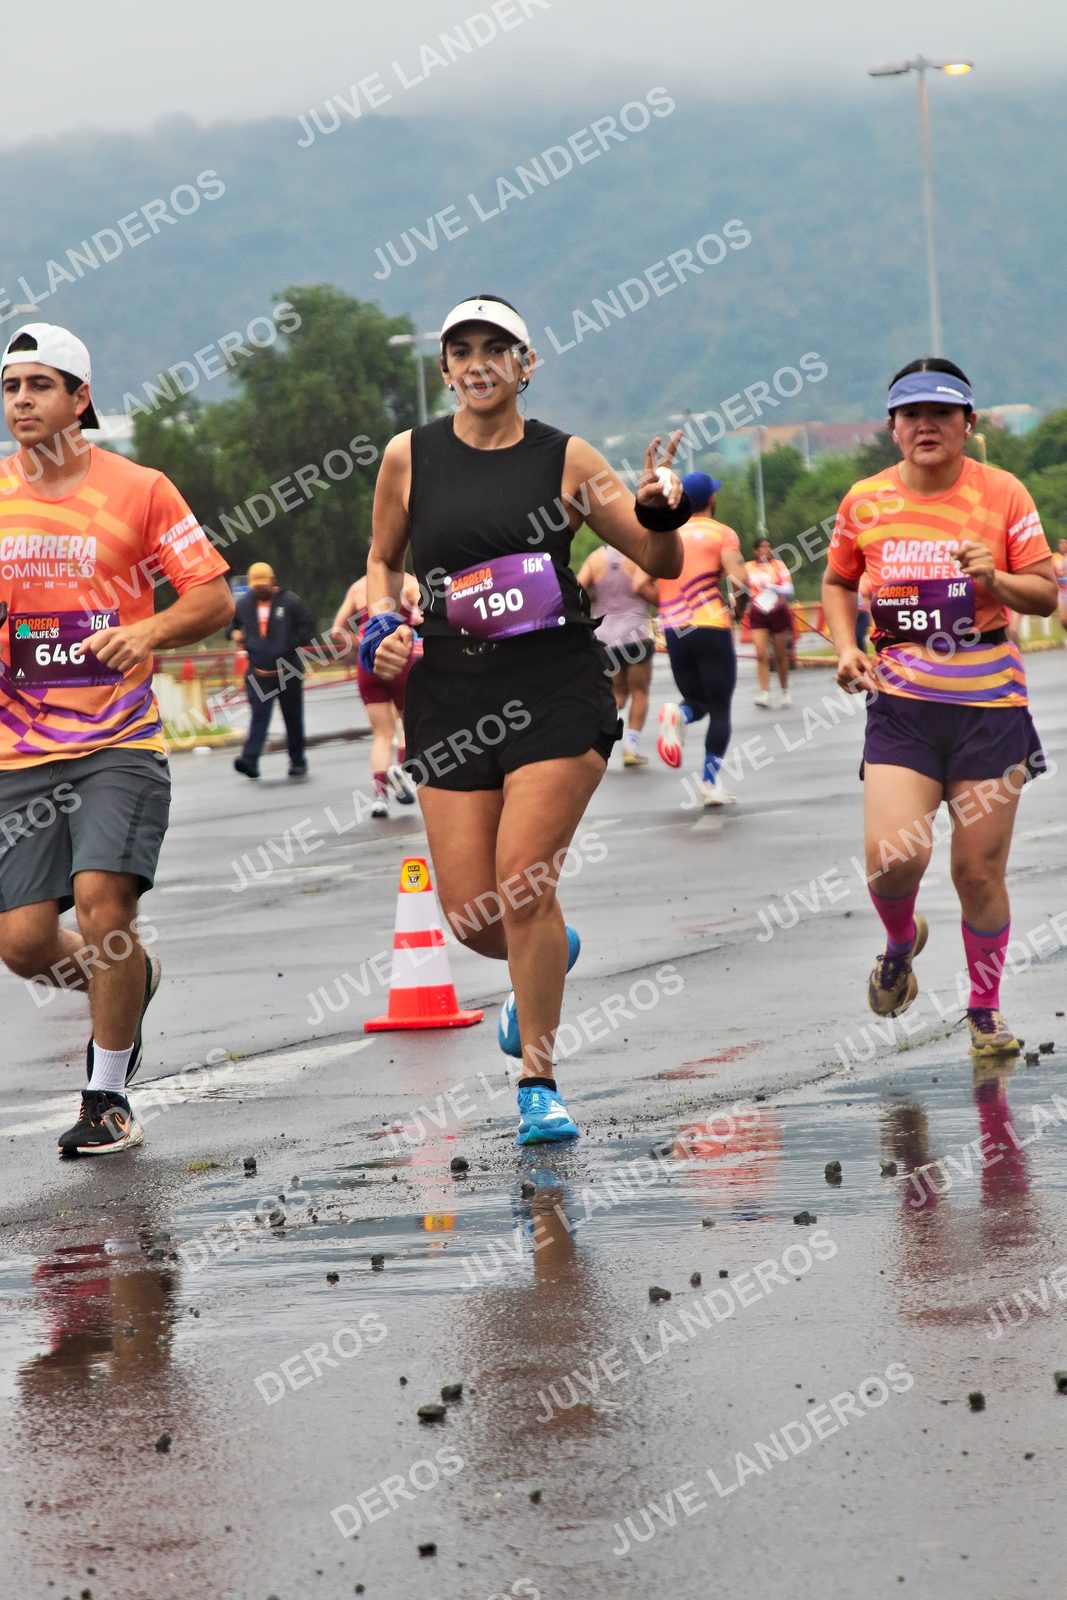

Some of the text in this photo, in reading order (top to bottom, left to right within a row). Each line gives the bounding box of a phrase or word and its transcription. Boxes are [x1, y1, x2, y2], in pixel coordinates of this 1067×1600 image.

[1, 535, 96, 561] CARRERA
[882, 540, 971, 562] CARRER
[451, 567, 493, 592] CARRERA
[877, 586, 919, 598] CARRERA
[473, 588, 524, 620] 190
[896, 610, 942, 631] 581
